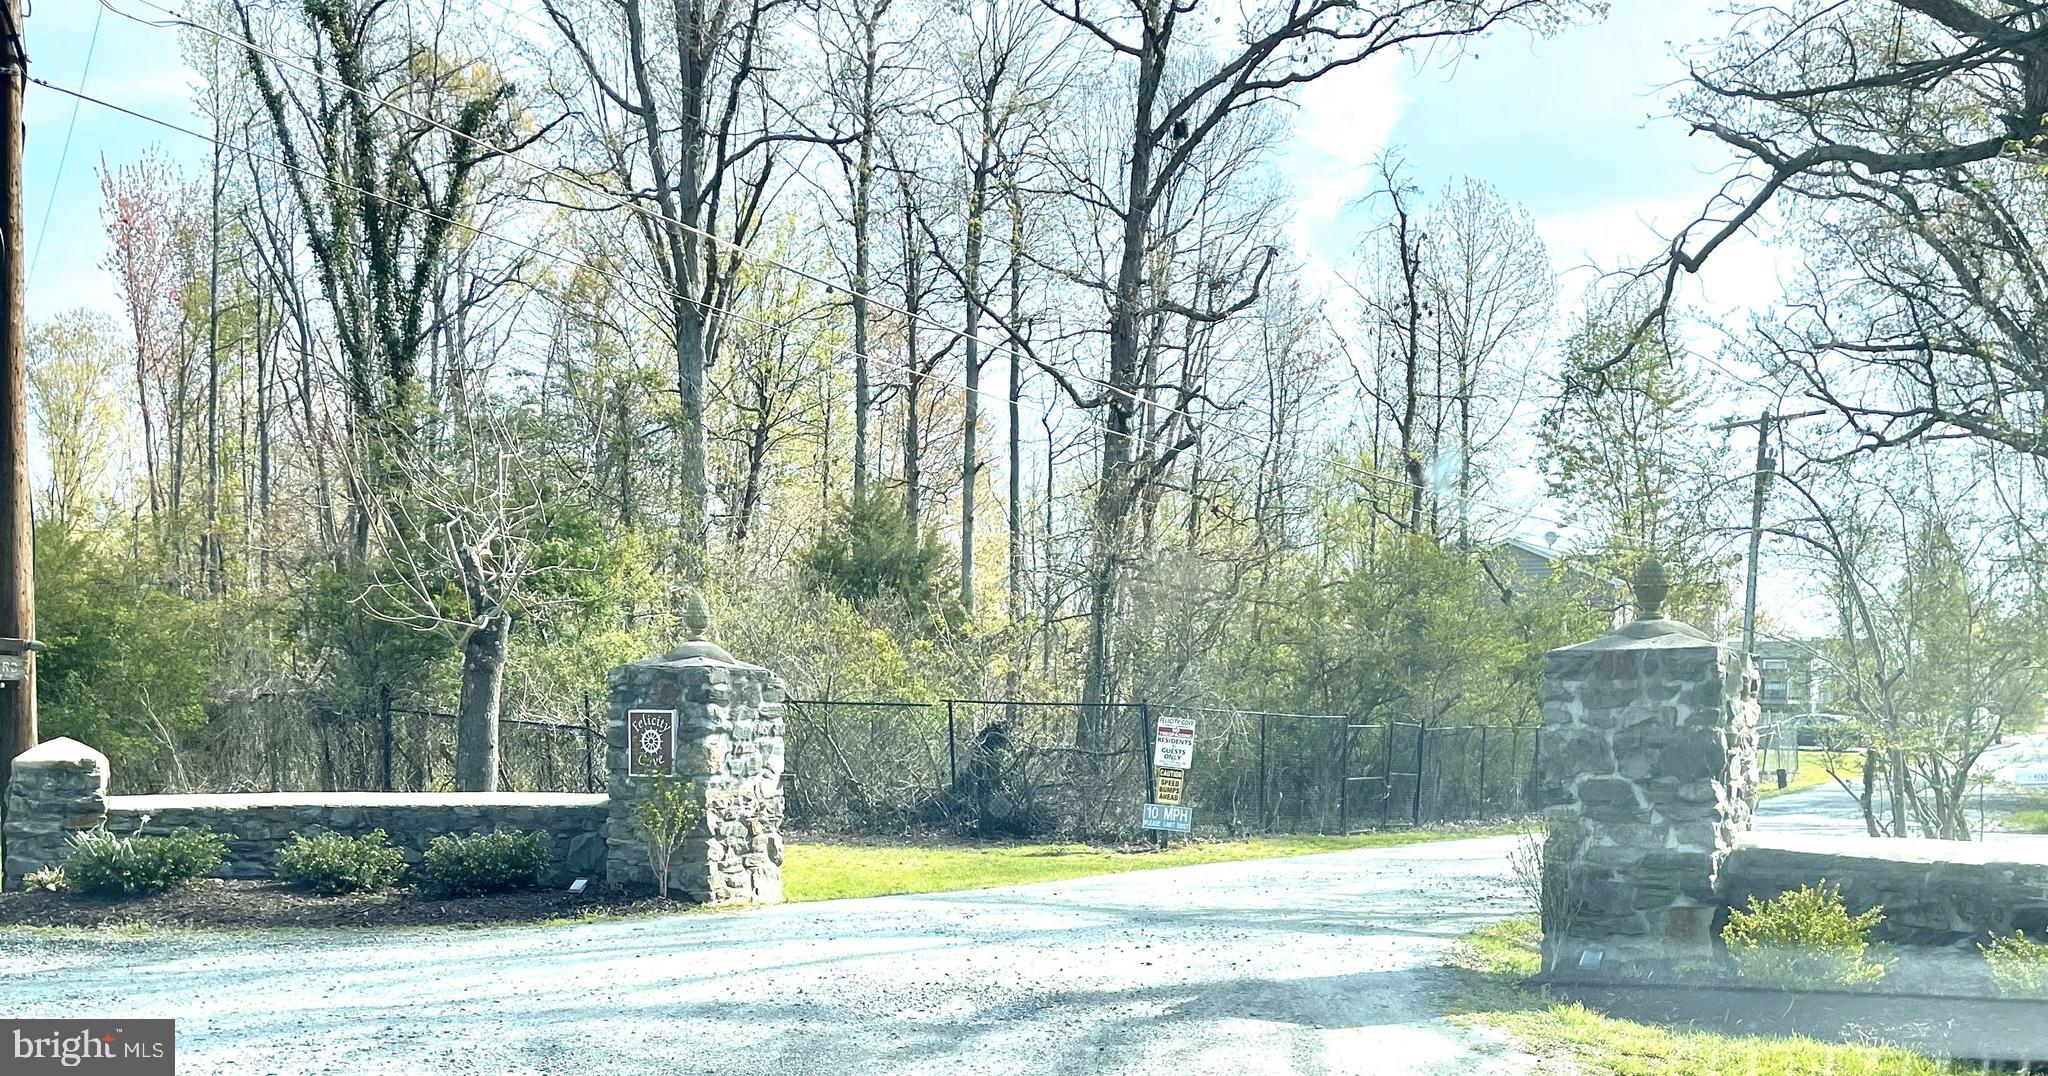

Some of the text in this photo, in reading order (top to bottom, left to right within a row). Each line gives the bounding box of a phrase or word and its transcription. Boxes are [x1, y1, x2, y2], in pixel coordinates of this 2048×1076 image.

[632, 713, 671, 733] Felicity
[1160, 717, 1181, 725] FELICITY
[1158, 737, 1192, 746] RESIDENTS
[1161, 747, 1186, 756] GUESTS
[1160, 769, 1182, 778] CAUTION
[1161, 779, 1180, 787] SPEED
[1159, 786, 1180, 794] BUMPS
[1158, 793, 1179, 801] AHEAD
[1147, 805, 1188, 822] 10 MPH
[1144, 819, 1161, 827] PLEASE
